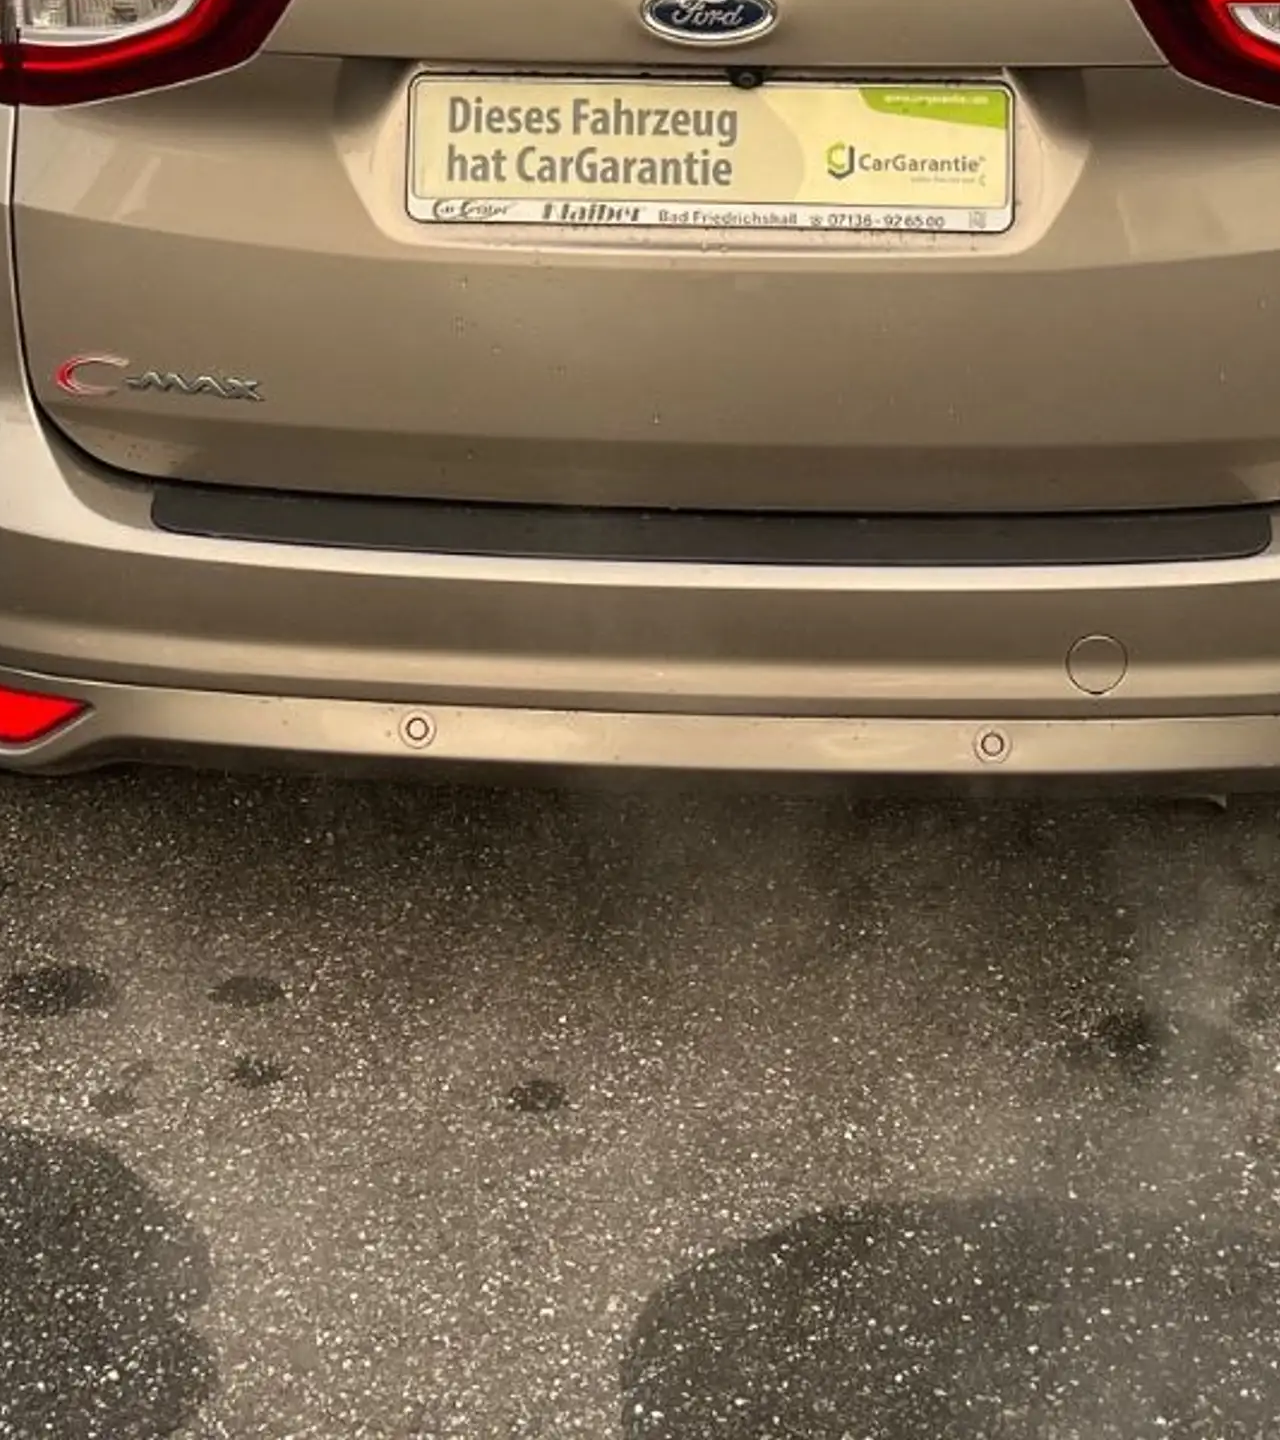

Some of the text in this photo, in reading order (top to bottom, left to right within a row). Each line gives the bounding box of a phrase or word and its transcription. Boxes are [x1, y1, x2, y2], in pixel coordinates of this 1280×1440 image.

[449, 96, 738, 147] Dieses Fahrzeug
[447, 144, 733, 186] hat CarGarantie
[858, 153, 980, 173] CarGarantie
[658, 209, 690, 223] Bad
